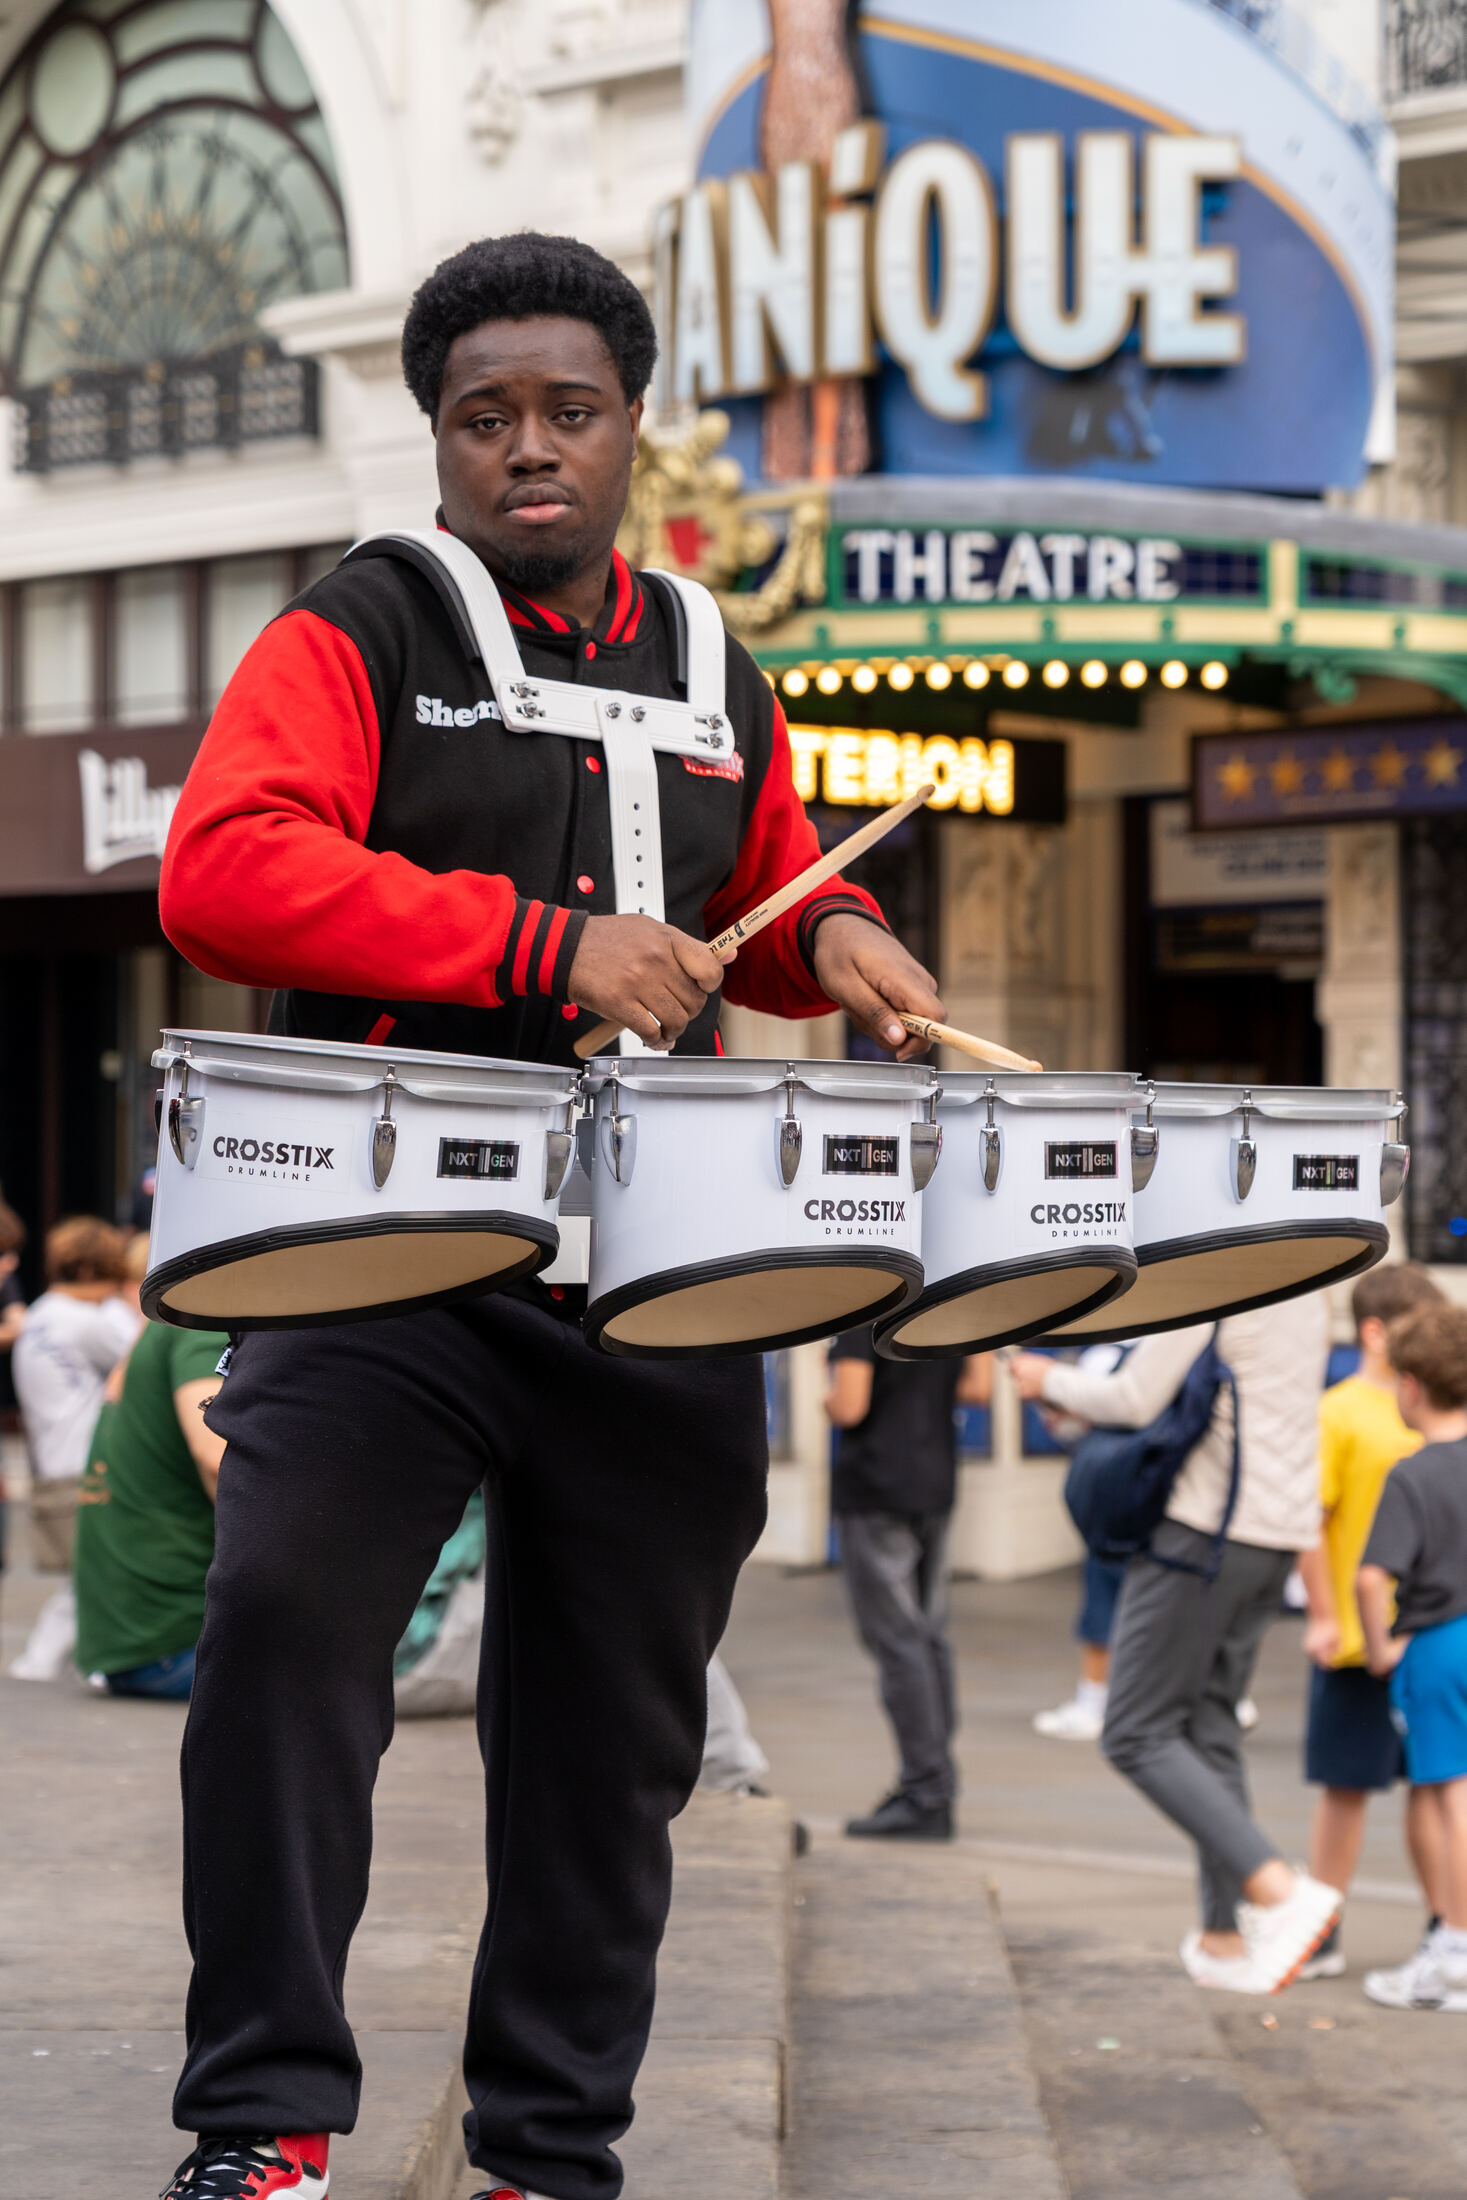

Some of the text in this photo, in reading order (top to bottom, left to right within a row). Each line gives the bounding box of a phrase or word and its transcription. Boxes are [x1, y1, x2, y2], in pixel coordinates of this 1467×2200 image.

[842, 529, 1182, 602] THEATRE
[213, 1135, 335, 1170] CROSSTIX
[448, 1151, 515, 1168] NXT GEN
[833, 1148, 894, 1163] NXT GEN
[1055, 1153, 1113, 1167] NXT GEN
[228, 1165, 311, 1182] DRUMLINE
[1302, 1166, 1355, 1180] NXT GEN
[803, 1199, 906, 1222] CROSSTIX
[1030, 1202, 1126, 1224] CROSSTIX
[825, 1227, 895, 1236] DRUMLINE
[1051, 1228, 1118, 1238] DRUMLINE
